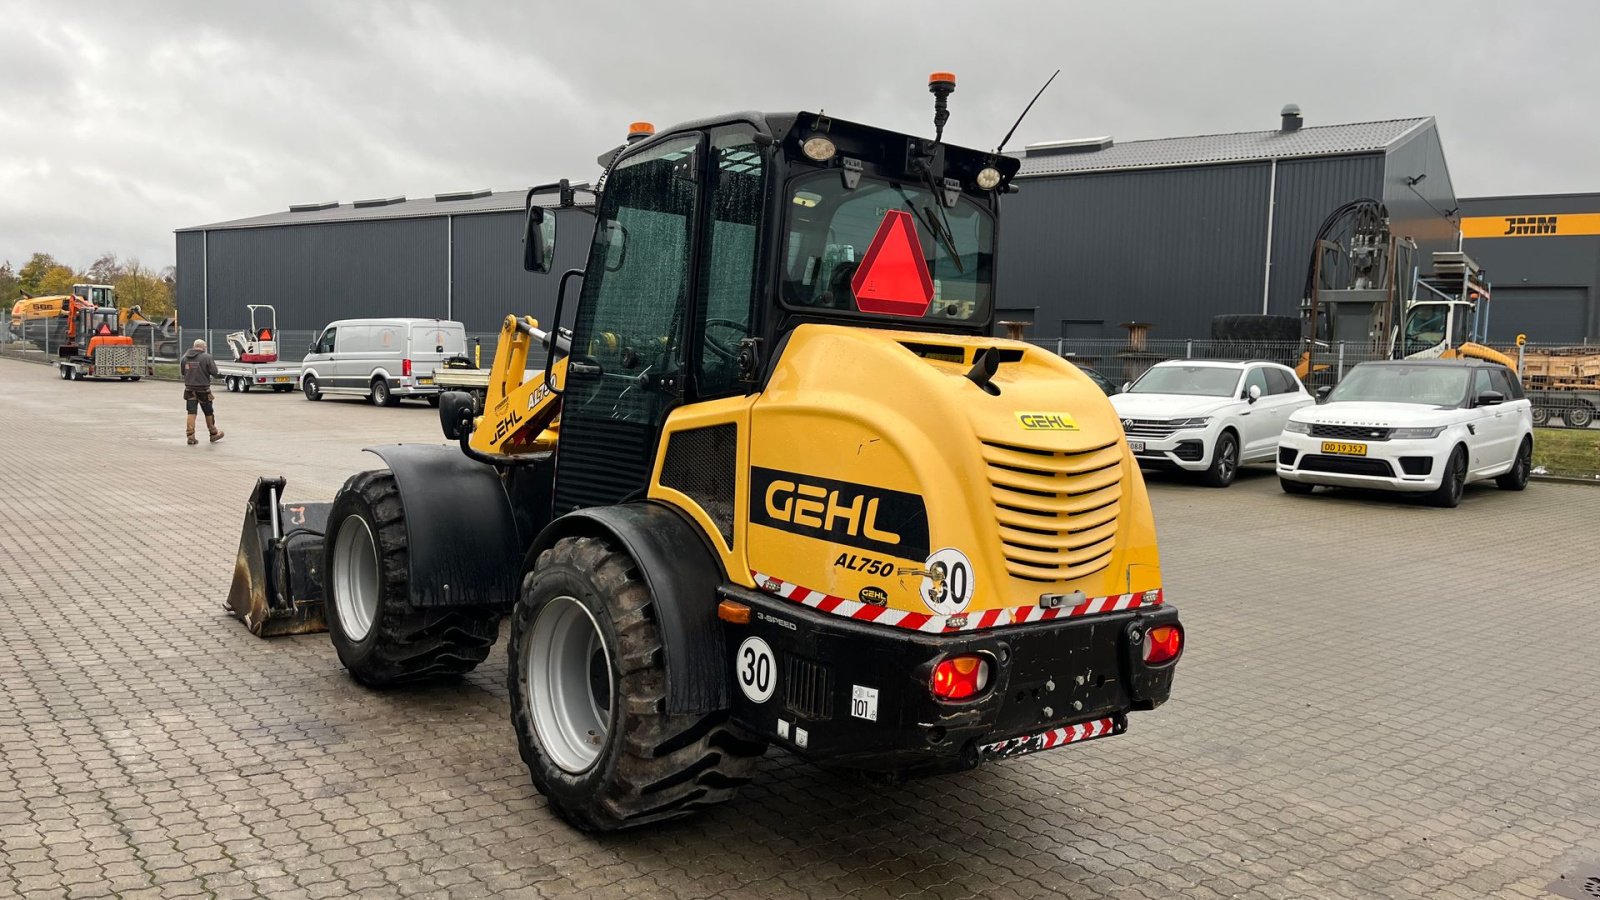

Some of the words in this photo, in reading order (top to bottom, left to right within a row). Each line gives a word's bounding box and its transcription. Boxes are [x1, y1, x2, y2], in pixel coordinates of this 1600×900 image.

[1504, 217, 1557, 235] JMM
[1020, 415, 1074, 428] GEHL
[1324, 443, 1336, 451] DD
[1337, 444, 1347, 452] 19
[1348, 445, 1363, 453] 352
[765, 479, 900, 545] GEHL
[834, 552, 894, 577] AL750
[861, 589, 887, 600] GEHL
[757, 612, 797, 631] 3-SPEED
[742, 647, 770, 693] 30
[853, 698, 868, 717] 101
